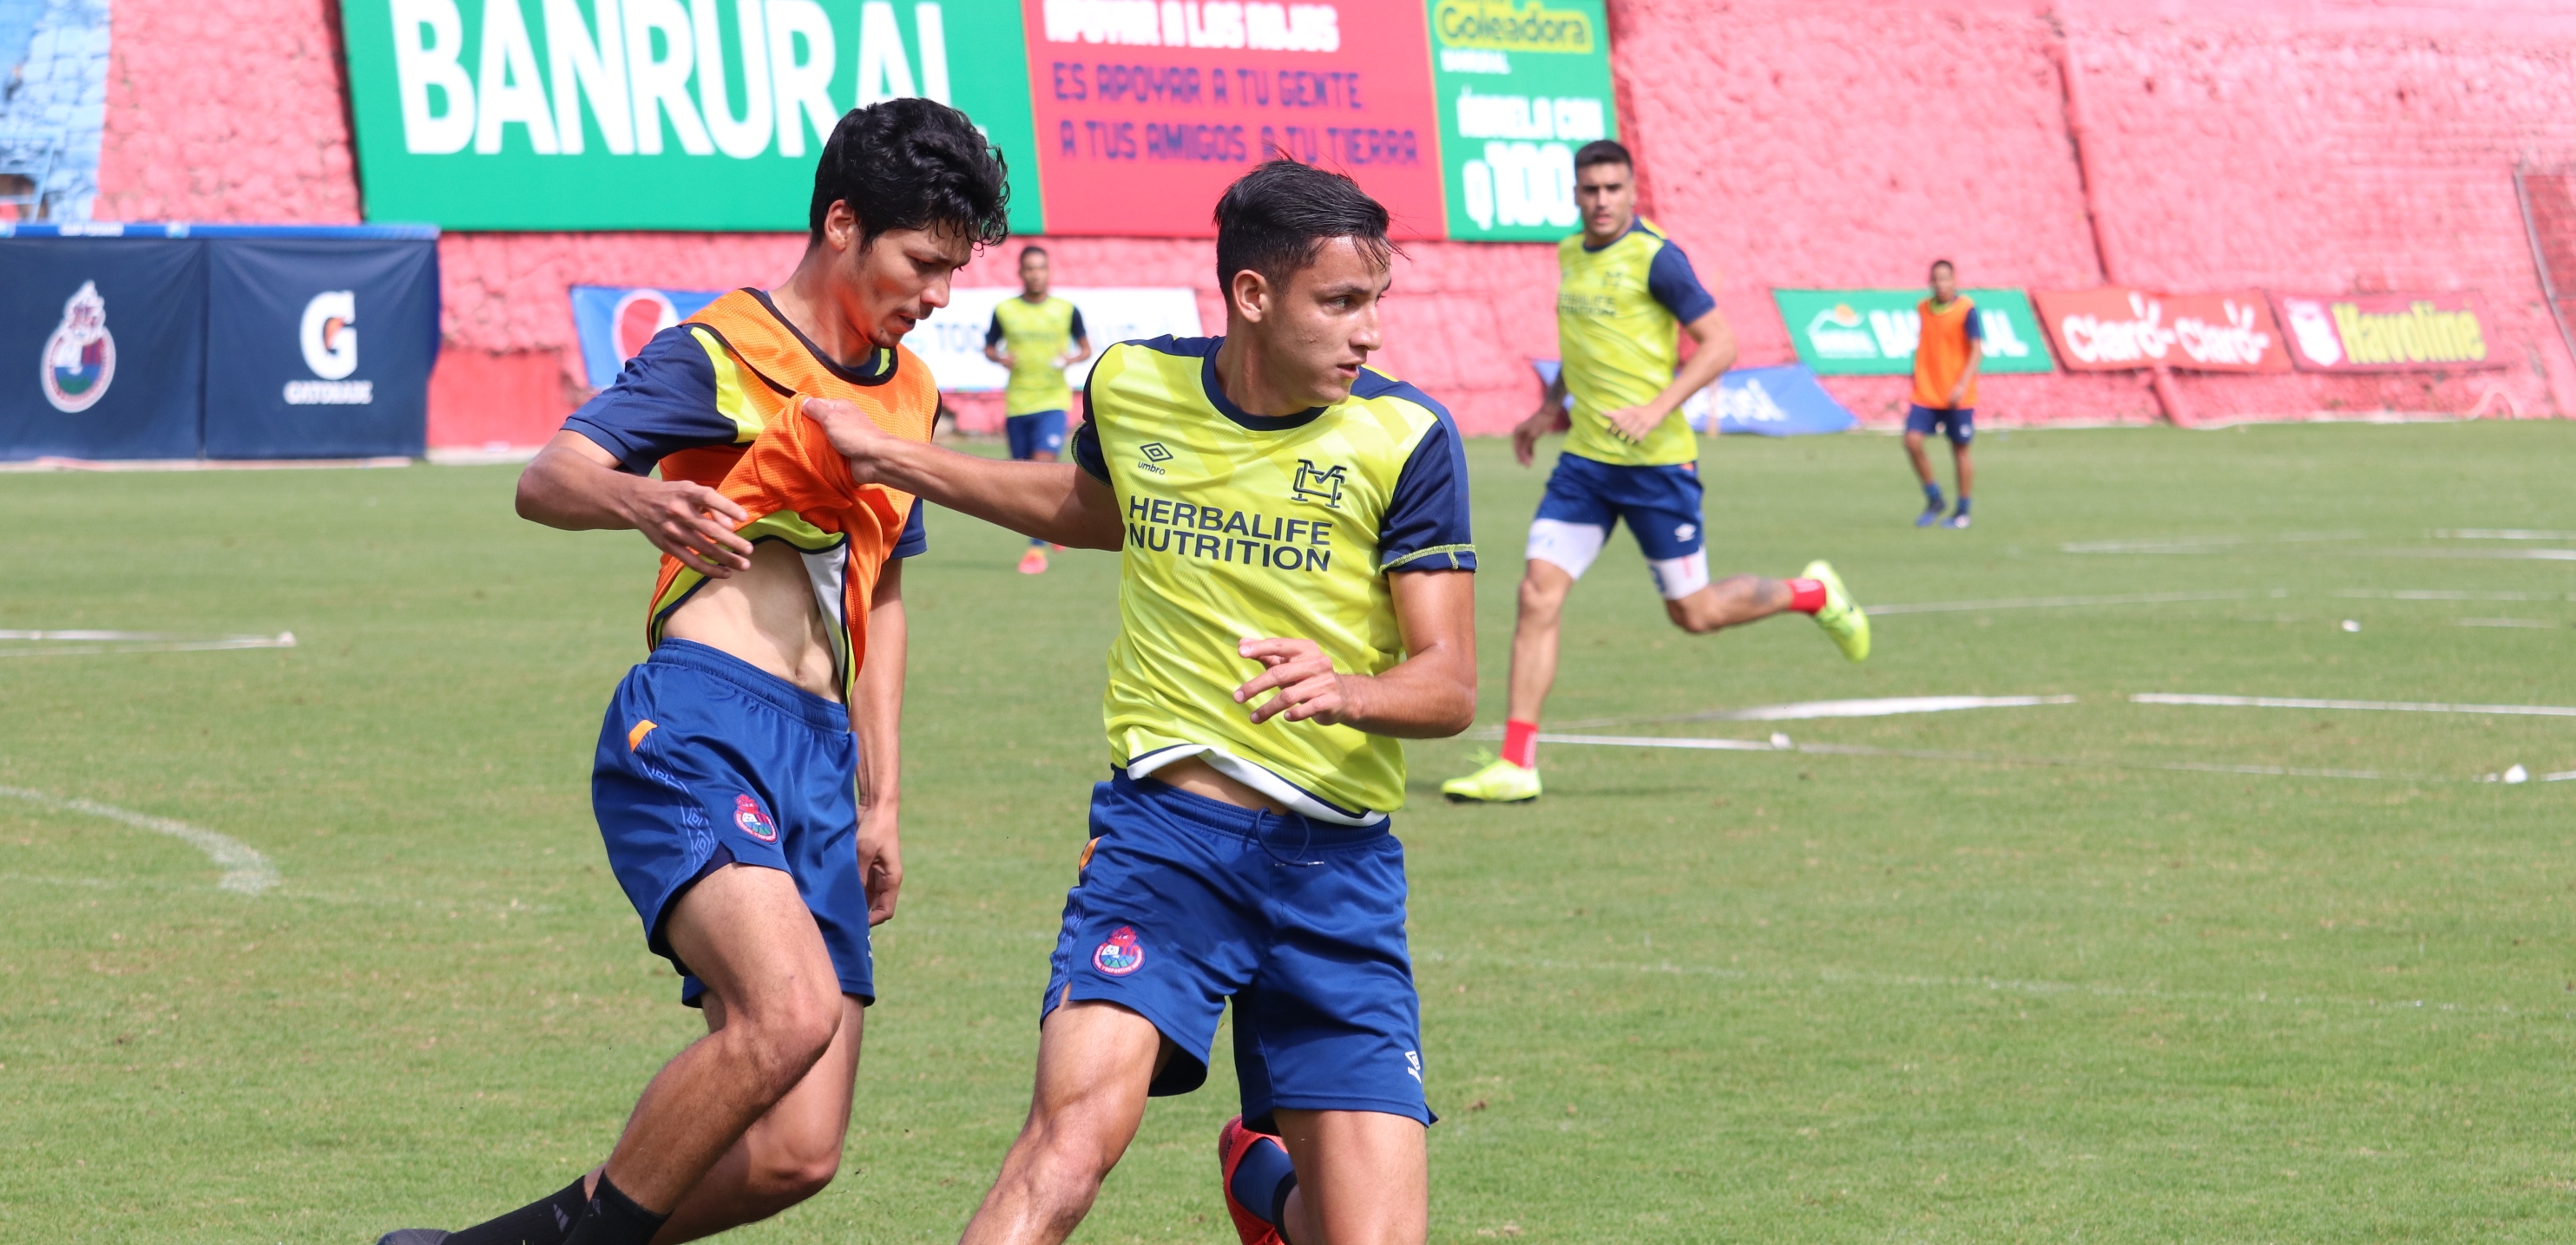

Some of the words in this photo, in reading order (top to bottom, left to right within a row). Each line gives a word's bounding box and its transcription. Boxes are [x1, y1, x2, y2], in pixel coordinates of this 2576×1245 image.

[1186, 3, 1245, 49] LOS
[1442, 3, 1586, 45] Goleadora
[390, 0, 989, 160] BANRURAL
[1052, 62, 1088, 101] ES
[1096, 63, 1203, 103] APOYAR
[1212, 68, 1228, 103] A
[1236, 69, 1270, 107] TU
[1278, 70, 1364, 109] GENTE
[1060, 120, 1077, 158] A
[1084, 120, 1137, 160] TUS
[1146, 122, 1247, 162] AMIGOS
[1260, 125, 1278, 161] A
[1285, 126, 1318, 163] TU
[1327, 127, 1419, 165] TIERRA
[1462, 141, 1579, 231] Q100
[2061, 304, 2170, 363] Claro
[2174, 307, 2264, 364] Claro
[2330, 301, 2487, 364] Havoline
[283, 380, 373, 405] GATORADE
[1138, 461, 1166, 475] umbro
[1129, 495, 1332, 545] HERBALIFE
[1129, 522, 1331, 572] NUTRITION
